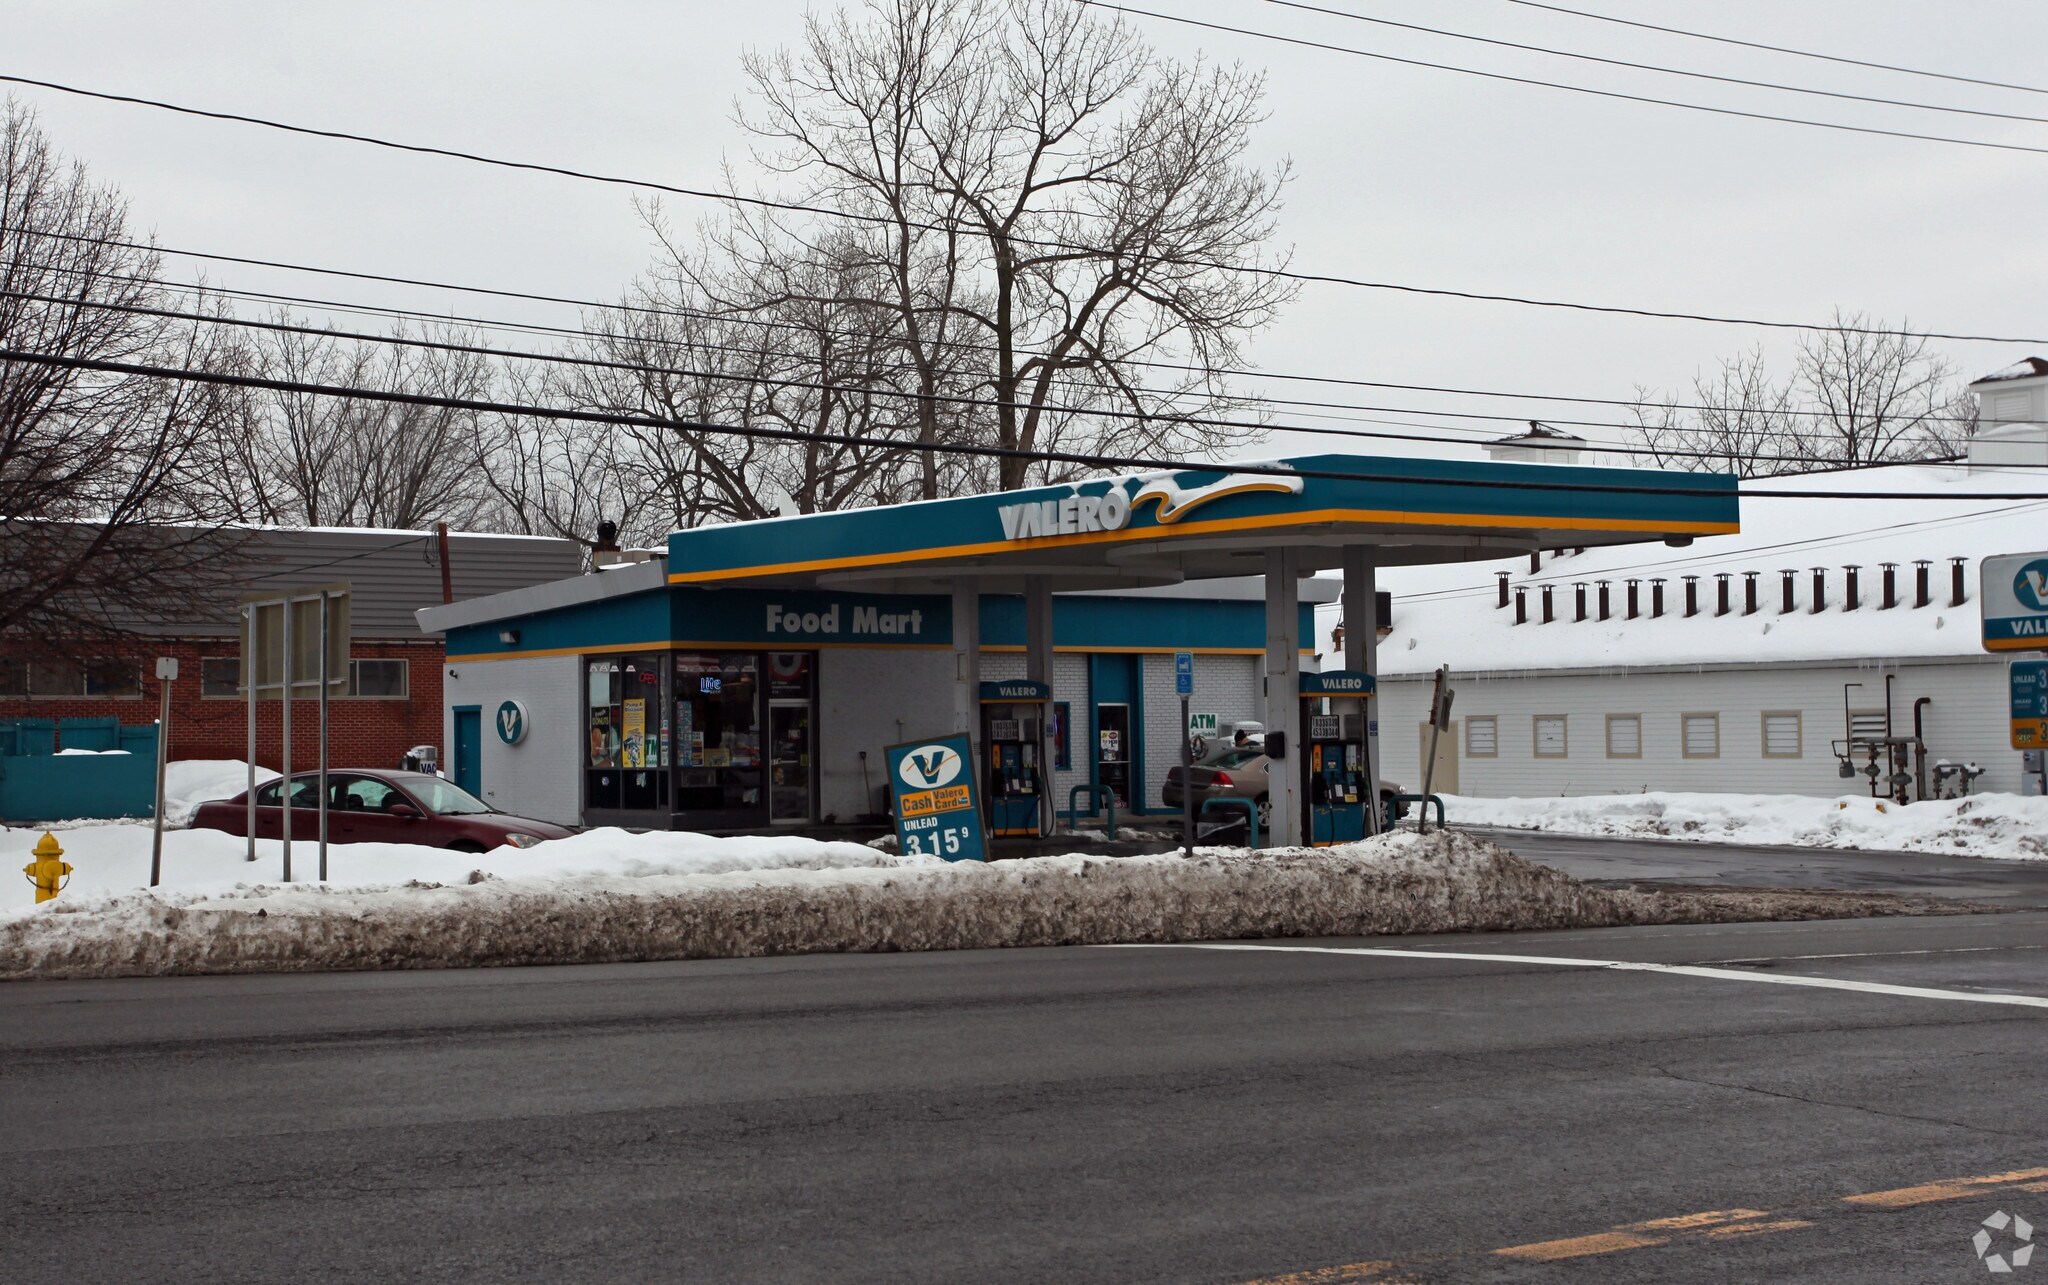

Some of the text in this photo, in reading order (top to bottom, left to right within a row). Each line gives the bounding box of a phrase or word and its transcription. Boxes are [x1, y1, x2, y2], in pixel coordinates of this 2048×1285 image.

[998, 492, 1131, 540] VALERO
[766, 604, 922, 634] Food Mart
[700, 677, 721, 694] Lite
[1322, 679, 1362, 689] VALERO
[2013, 675, 2036, 683] UNLEAD
[1000, 687, 1037, 696] VALERO
[592, 717, 609, 725] DONUTS
[1190, 714, 1216, 729] ATM
[646, 739, 657, 755] TM
[421, 763, 436, 774] VAC
[933, 788, 964, 800] Valero
[902, 795, 933, 812] Cash
[935, 798, 957, 810] Card
[904, 817, 938, 831] UNLEAD
